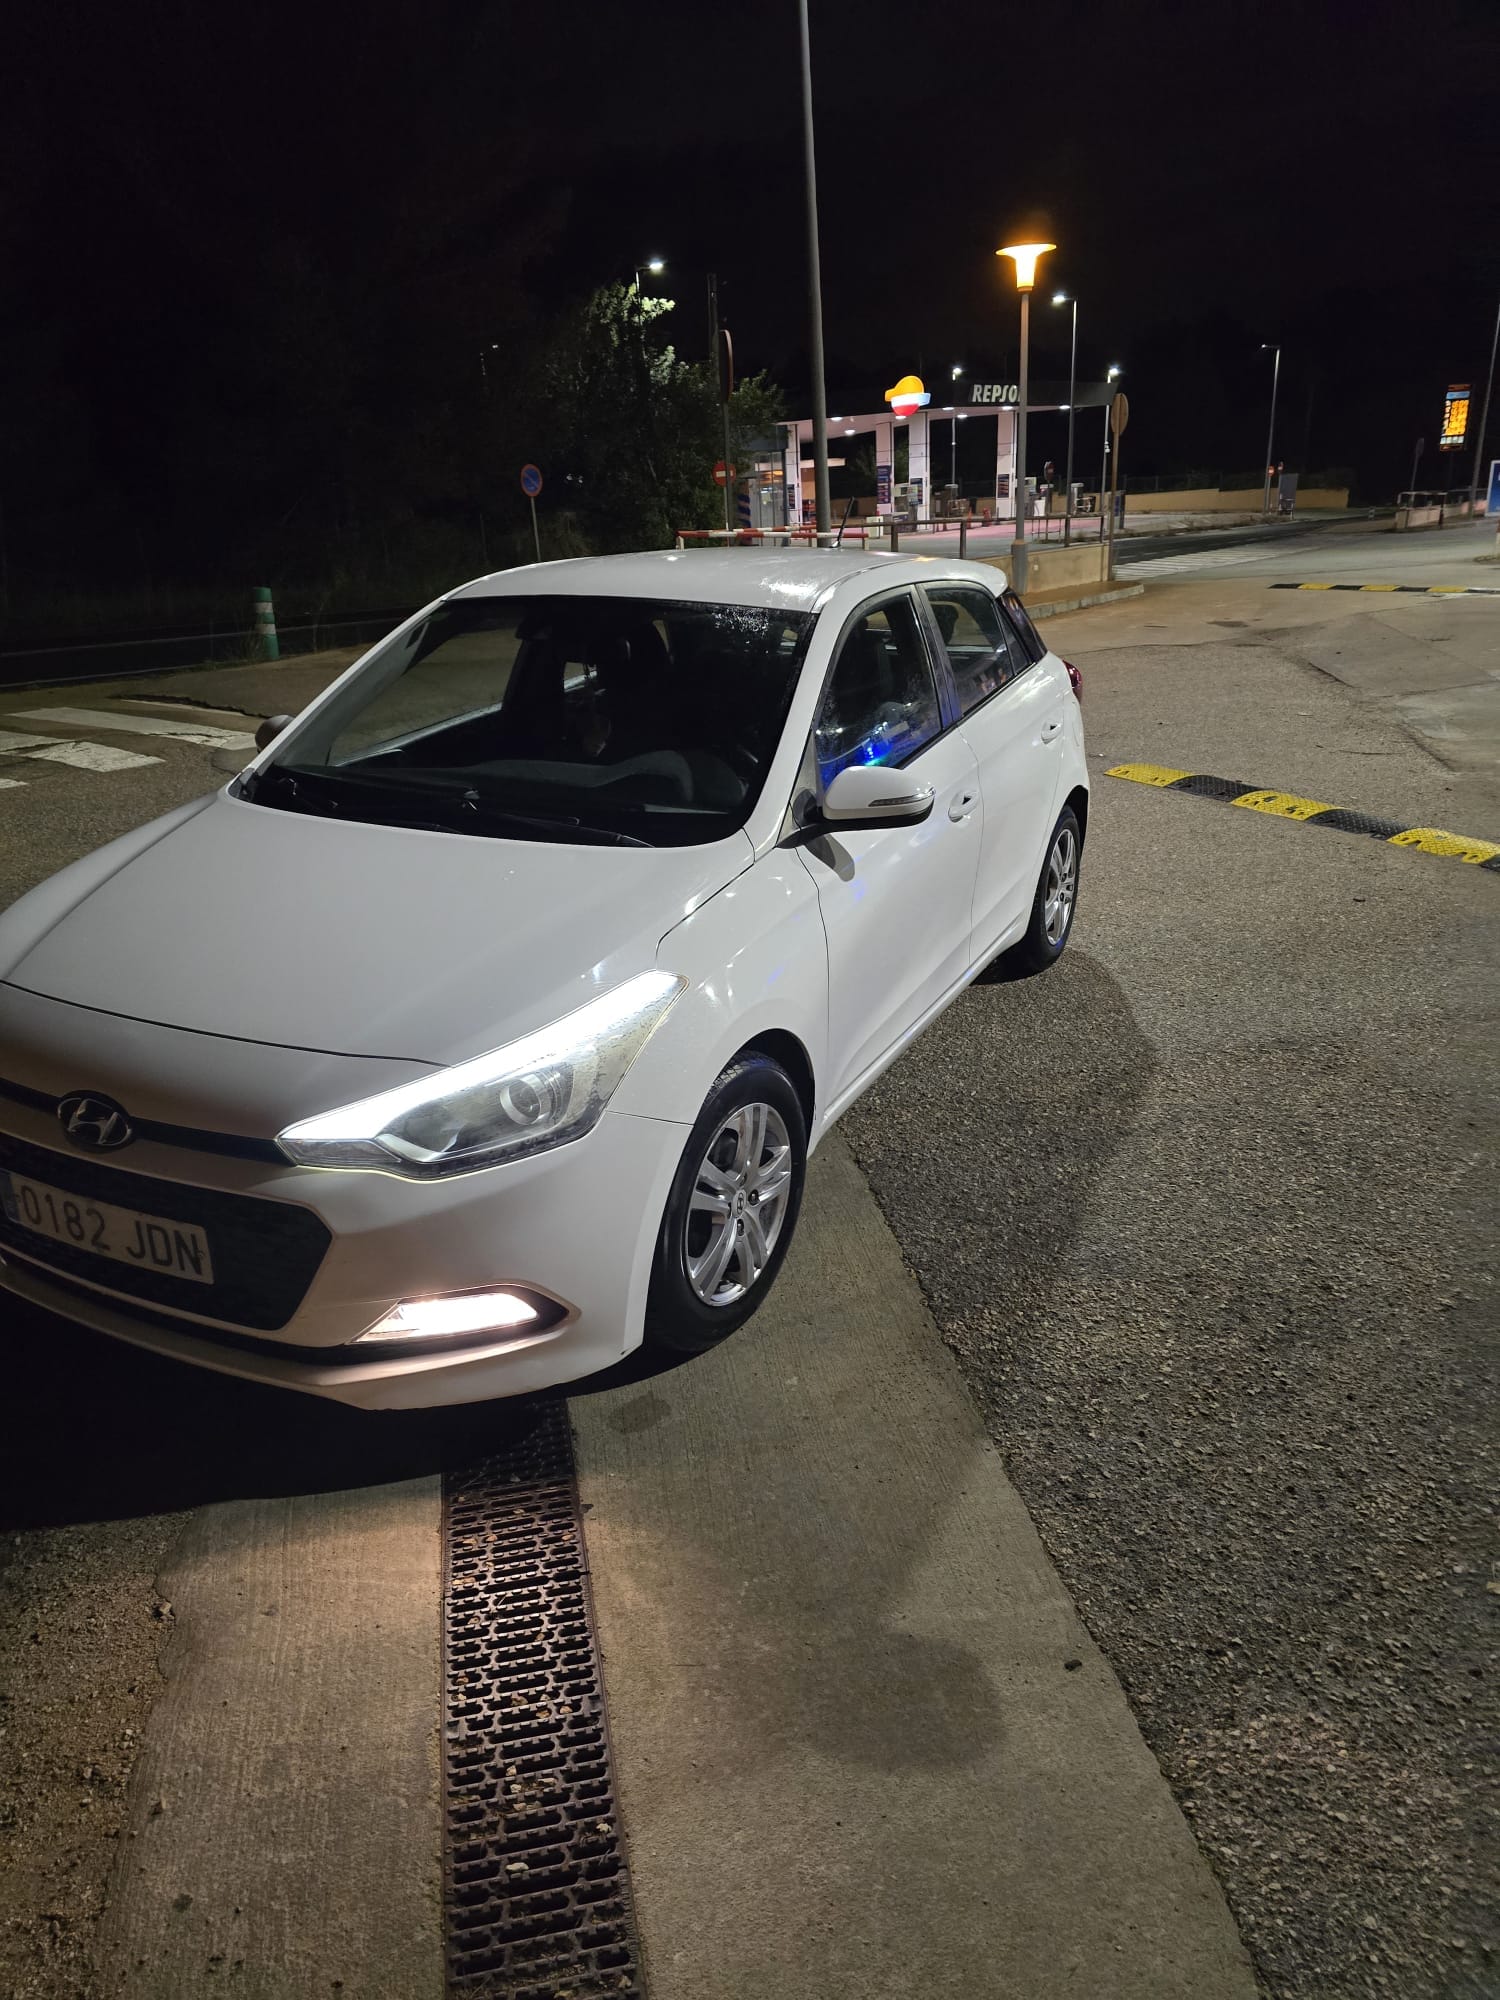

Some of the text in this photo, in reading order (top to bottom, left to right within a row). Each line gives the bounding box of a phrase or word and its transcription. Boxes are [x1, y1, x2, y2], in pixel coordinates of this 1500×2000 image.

[972, 384, 1020, 403] REPSO
[20, 1185, 203, 1275] 0182 JDN
